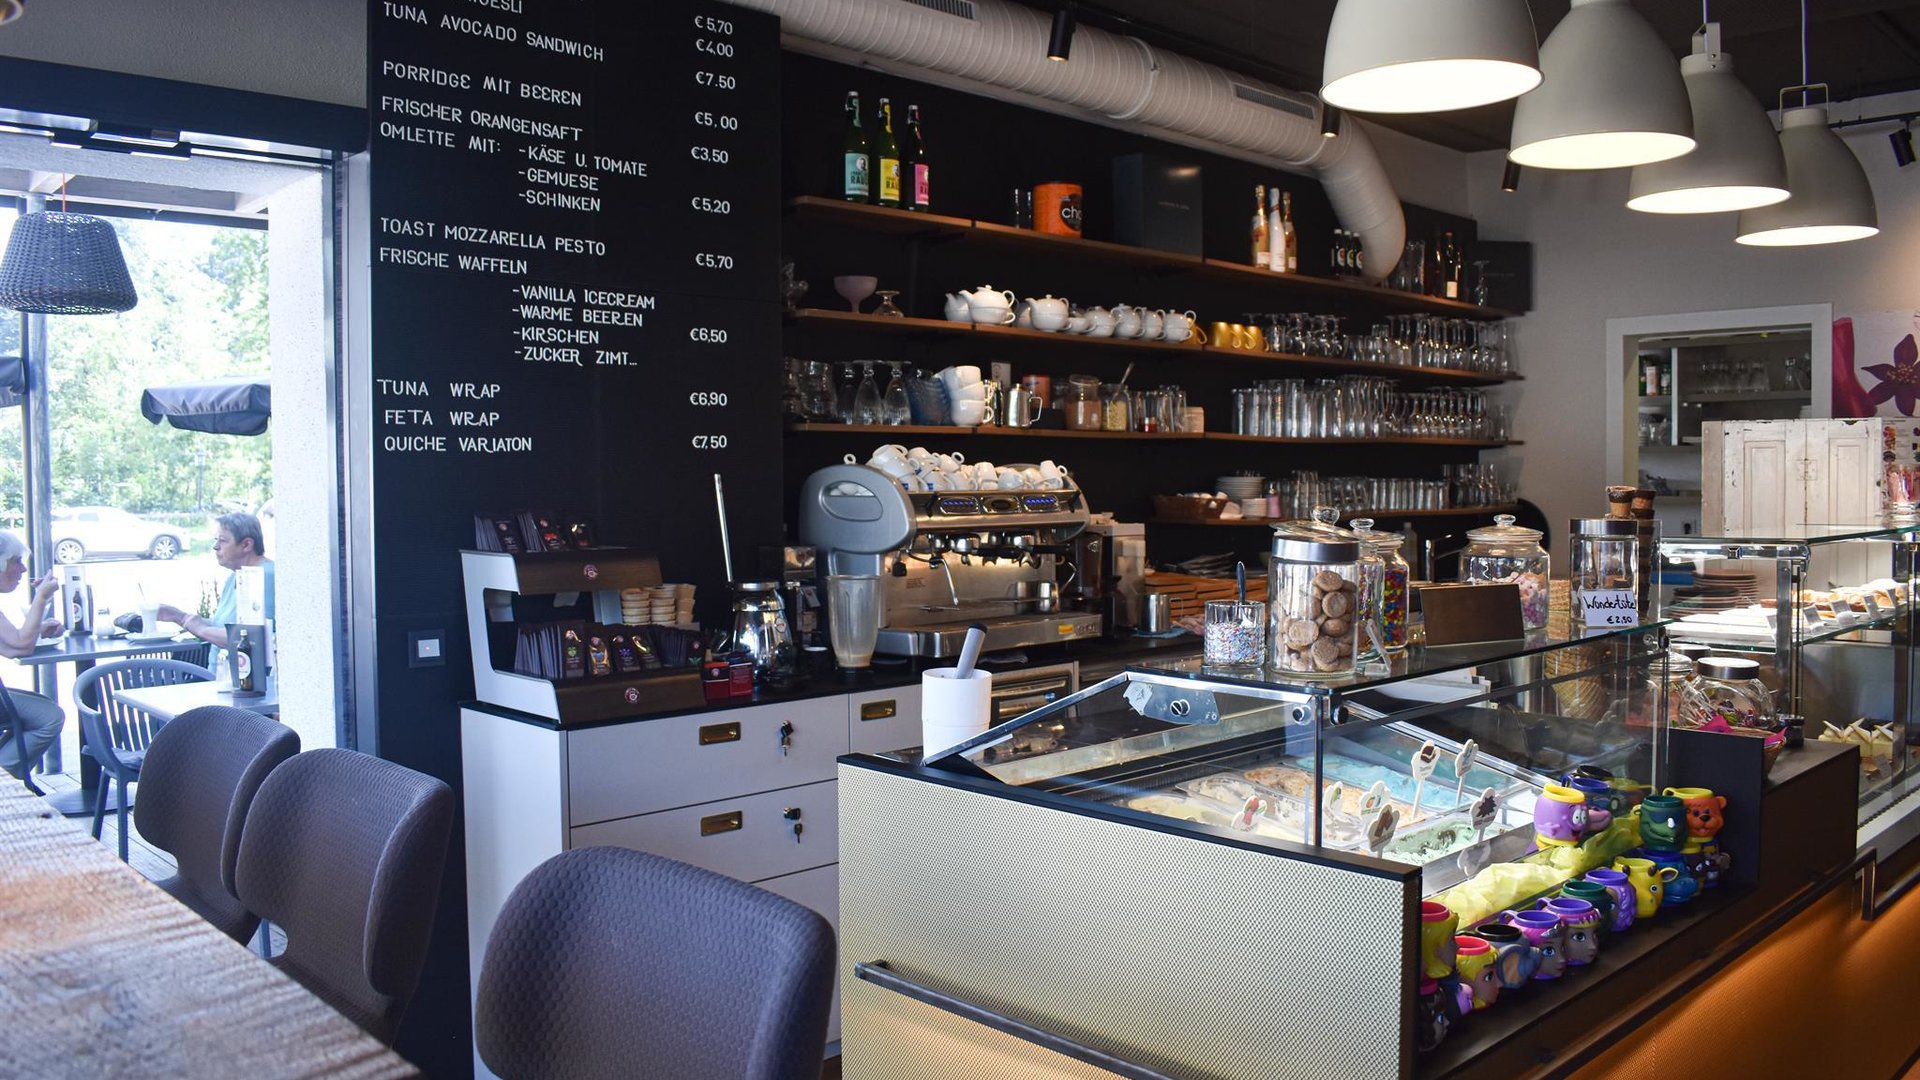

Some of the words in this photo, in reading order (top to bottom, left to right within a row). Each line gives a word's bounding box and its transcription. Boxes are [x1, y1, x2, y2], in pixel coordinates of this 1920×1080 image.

[384, 1, 427, 25] TUNA
[440, 13, 517, 42] AVOCADO
[526, 31, 604, 63] SANDWICH
[383, 60, 471, 91] PORRIDGE
[482, 75, 512, 95] MIT
[520, 83, 582, 107] BEEREN
[382, 95, 463, 124] FRISCHER
[470, 110, 583, 142] ORANGENSAFT
[380, 121, 456, 148] OMLETTE
[468, 135, 501, 154] MIT:
[518, 144, 566, 165] -KÄSE
[576, 152, 588, 168] U.
[593, 155, 648, 177] TOMATE
[518, 168, 599, 191] -GEMUESE
[518, 189, 601, 212] -SCHINKEN
[380, 216, 436, 241] TOAST
[444, 225, 546, 250] MOZZARELLA
[555, 236, 606, 257] PESTO
[379, 246, 450, 269] FRISCHE
[458, 254, 528, 275] WAFFELN
[512, 284, 577, 304] -VANILLA
[583, 288, 656, 311] ICECREAM
[512, 304, 573, 323] -WARME
[582, 308, 643, 328] BEEREN
[512, 325, 600, 345] -KIRSCHEN
[514, 345, 584, 367] -ZUCKER
[376, 378, 430, 397] TUNA
[449, 382, 501, 400] WRAP
[384, 409, 434, 426] FETA
[449, 410, 500, 427] WRAP
[384, 435, 447, 452] QUICHE
[458, 436, 533, 453] VARIATON
[1583, 593, 1636, 610] Wundertüte
